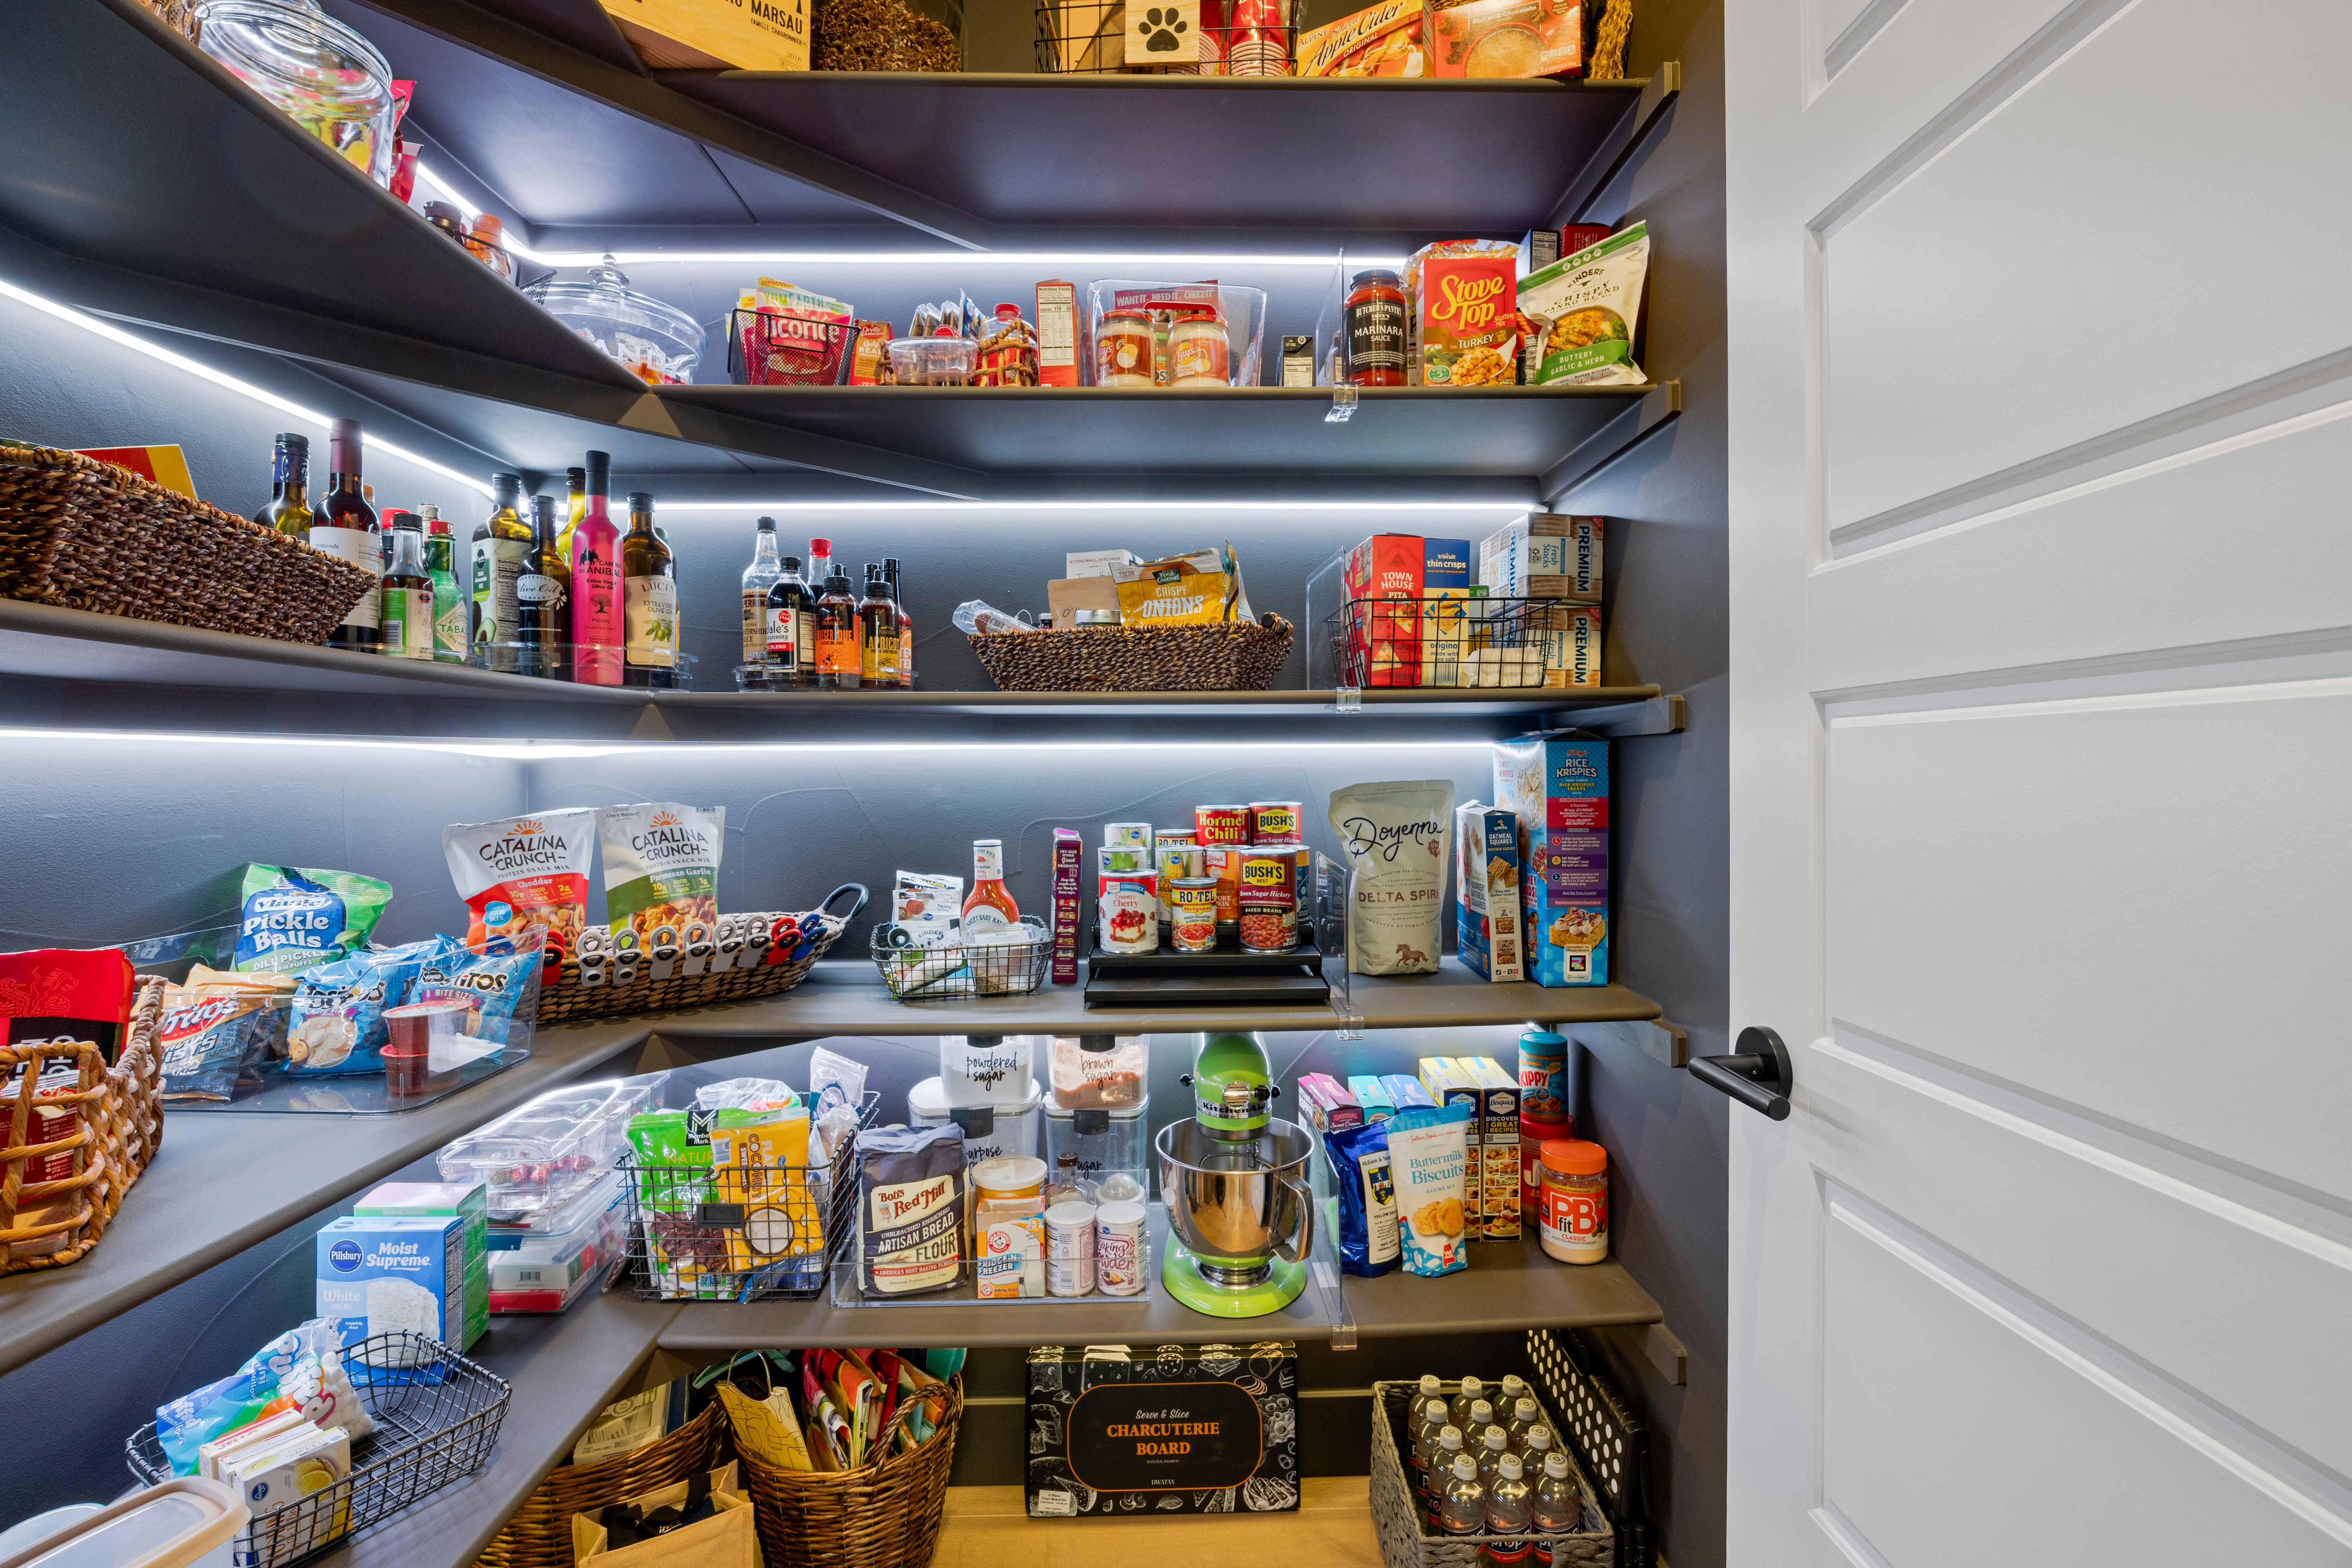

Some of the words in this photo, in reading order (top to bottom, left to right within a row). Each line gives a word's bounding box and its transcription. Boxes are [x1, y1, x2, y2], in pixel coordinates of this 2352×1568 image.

[751, 0, 802, 34] MARSAU
[1501, 5, 1536, 18] Chocolate
[1303, 28, 1357, 76] Apple
[1357, 2, 1405, 37] Cider
[1343, 32, 1378, 57] ORIGINAL
[787, 51, 802, 62] 2016
[1567, 269, 1604, 288] KINDER'S
[1117, 296, 1138, 307] WANT
[1138, 294, 1147, 303] IT
[1432, 275, 1505, 320] Stove
[1544, 299, 1579, 313] PANKO
[1584, 286, 1619, 302] BLEND
[1554, 280, 1610, 306] CRISPY
[1356, 305, 1384, 318] BUTCHER'S
[1385, 305, 1402, 317] PANTRY
[1457, 302, 1495, 331] Top
[1494, 313, 1514, 323] Stuffing
[1355, 325, 1403, 338] MARINARA
[1458, 333, 1494, 350] TURKEY
[1178, 347, 1195, 362] Lay's
[1559, 350, 1593, 363] BUTTERY
[1551, 363, 1575, 375] GARLIC
[1585, 355, 1604, 366] HERB
[1577, 526, 1590, 592] PREMIUM
[586, 566, 621, 577] ANIBAL
[1382, 572, 1413, 581] TOWN
[1156, 585, 1187, 598] CRISPY
[1381, 580, 1414, 590] HOUSE
[1142, 595, 1204, 619] ONIONS
[868, 636, 900, 650] APRICOT
[1575, 617, 1587, 684] PREMIUM
[1565, 759, 1588, 768] RICE
[1556, 767, 1597, 779] KRISPIES
[1199, 813, 1245, 826] Hormel
[1260, 815, 1294, 827] BUSH'S
[632, 827, 709, 851] CATALINA
[1204, 827, 1238, 840] Chili
[1343, 817, 1445, 862] Doyenne
[479, 835, 567, 861] CATALINA
[646, 843, 701, 861] CRUNCH
[495, 849, 556, 871] CRUNCH
[1207, 852, 1225, 862] Libby's
[497, 869, 525, 879] PROTEIN
[526, 866, 553, 875] SNACK
[650, 871, 685, 883] Parmesan
[686, 867, 711, 877] Garlic
[1245, 866, 1283, 879] BUSH'S
[517, 877, 553, 889] Cheddar
[1121, 884, 1145, 892] COMSTOCK
[1270, 890, 1291, 899] Hickory
[1359, 890, 1405, 903] DELTA
[1113, 899, 1139, 908] Cherry
[243, 911, 329, 936] Pickle
[253, 930, 322, 953] Balls
[253, 957, 279, 972] DILL
[281, 950, 328, 964] PICKLE
[290, 960, 313, 969] PUFFS
[206, 1045, 234, 1058] FLAVORED
[966, 1051, 1017, 1077] powdered
[1081, 1056, 1113, 1072] brown
[973, 1070, 1005, 1091] sugar
[1085, 1069, 1116, 1089] sugar
[1203, 1102, 1267, 1114] KitchenAid
[1490, 1098, 1515, 1107] Bisquick
[50, 1129, 75, 1138] MICROWAVE
[749, 1133, 762, 1199] COCONUT
[1410, 1149, 1463, 1169] Buttermilk
[1411, 1164, 1464, 1185] Biscuits
[878, 1188, 904, 1203] Bob's
[894, 1196, 921, 1219] Red
[920, 1183, 946, 1207] Mill
[1550, 1191, 1598, 1235] PB
[881, 1221, 920, 1239] UNBLEACHED
[921, 1206, 950, 1225] ENRICHED
[1559, 1217, 1572, 1234] fit
[878, 1230, 920, 1254] ARTISAN
[922, 1216, 954, 1240] BREAD
[378, 1242, 418, 1255] Moist
[915, 1238, 957, 1263] FLOUR
[330, 1250, 362, 1263] Pillsbury
[978, 1262, 1014, 1275] FREEZER
[323, 1289, 361, 1302] White
[1136, 1409, 1158, 1420] Serve
[1161, 1410, 1167, 1419] &
[1170, 1408, 1190, 1419] Slice
[1107, 1421, 1220, 1437] CHARCUTERIE
[1136, 1442, 1191, 1456] BOARD
